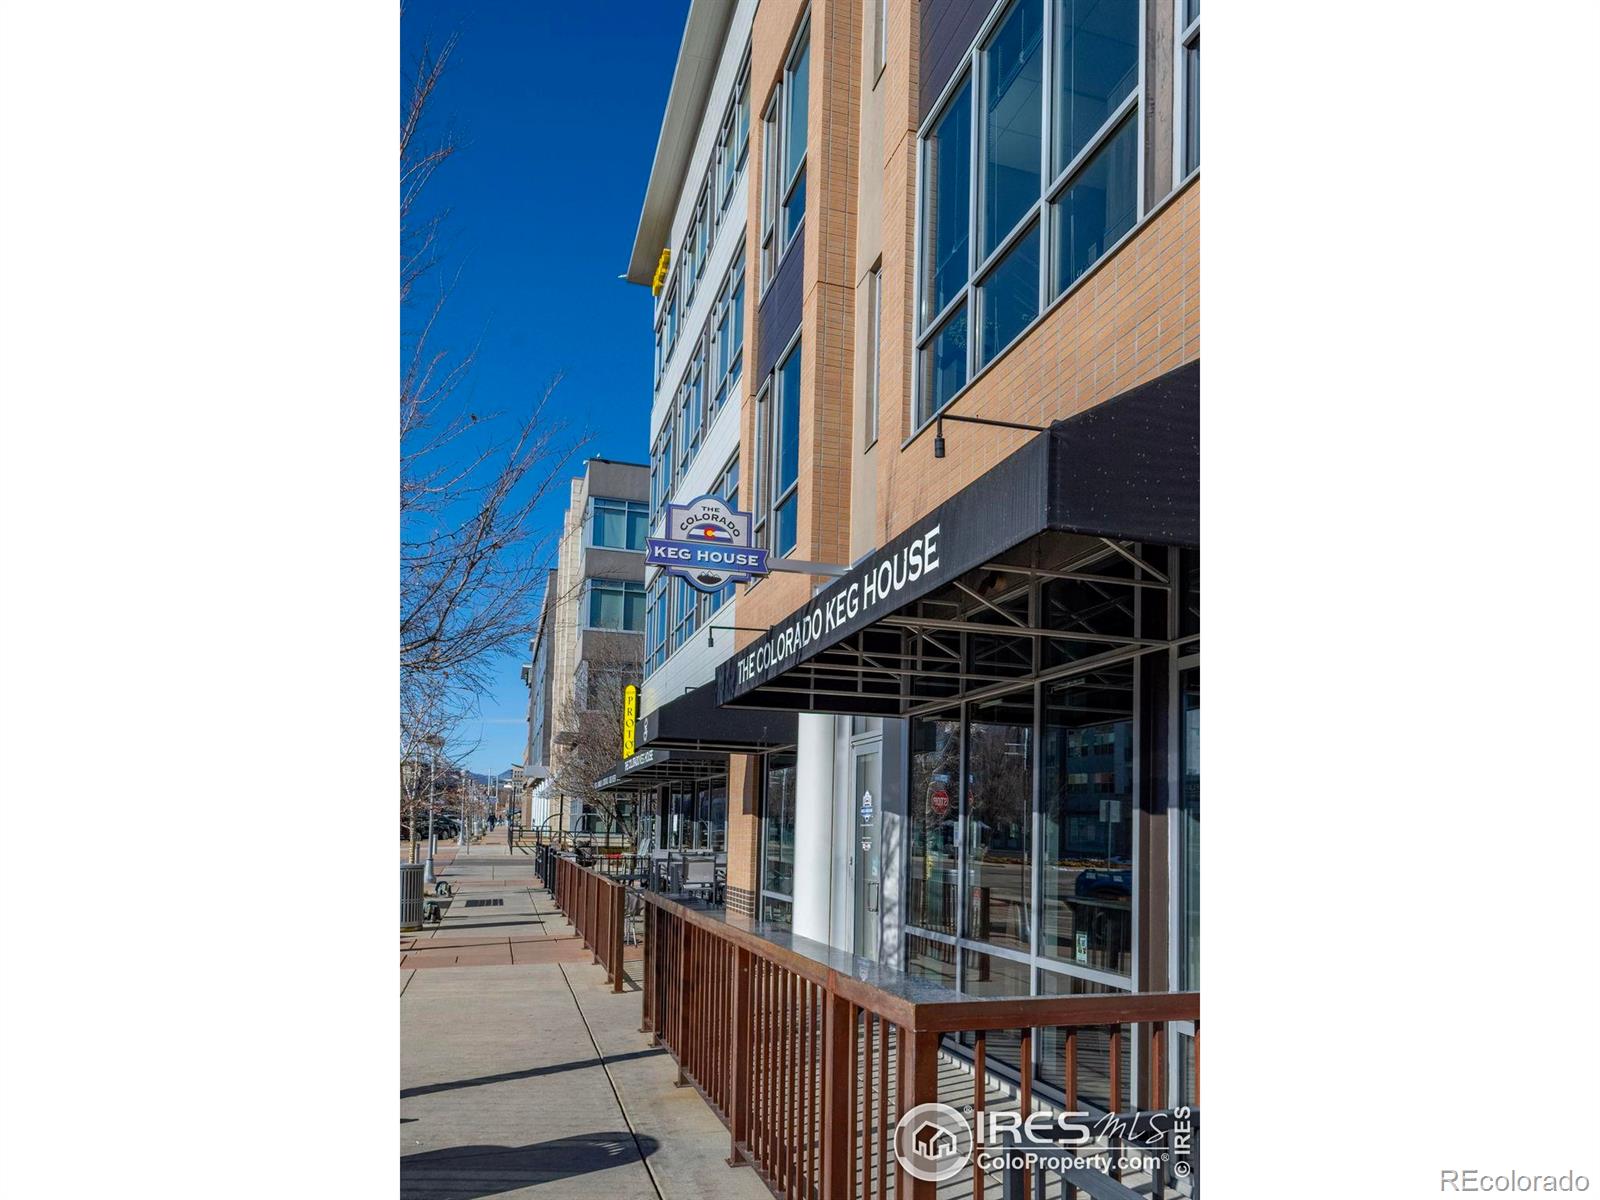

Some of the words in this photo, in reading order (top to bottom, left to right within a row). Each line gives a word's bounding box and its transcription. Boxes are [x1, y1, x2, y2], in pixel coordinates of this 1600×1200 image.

[680, 513, 741, 538] COLORADO
[654, 546, 692, 560] KEG
[697, 550, 759, 567] HOUSE
[737, 651, 756, 685] THE
[756, 608, 823, 674] COLORADO
[825, 582, 860, 634] KEG
[863, 523, 941, 611] HOUSE
